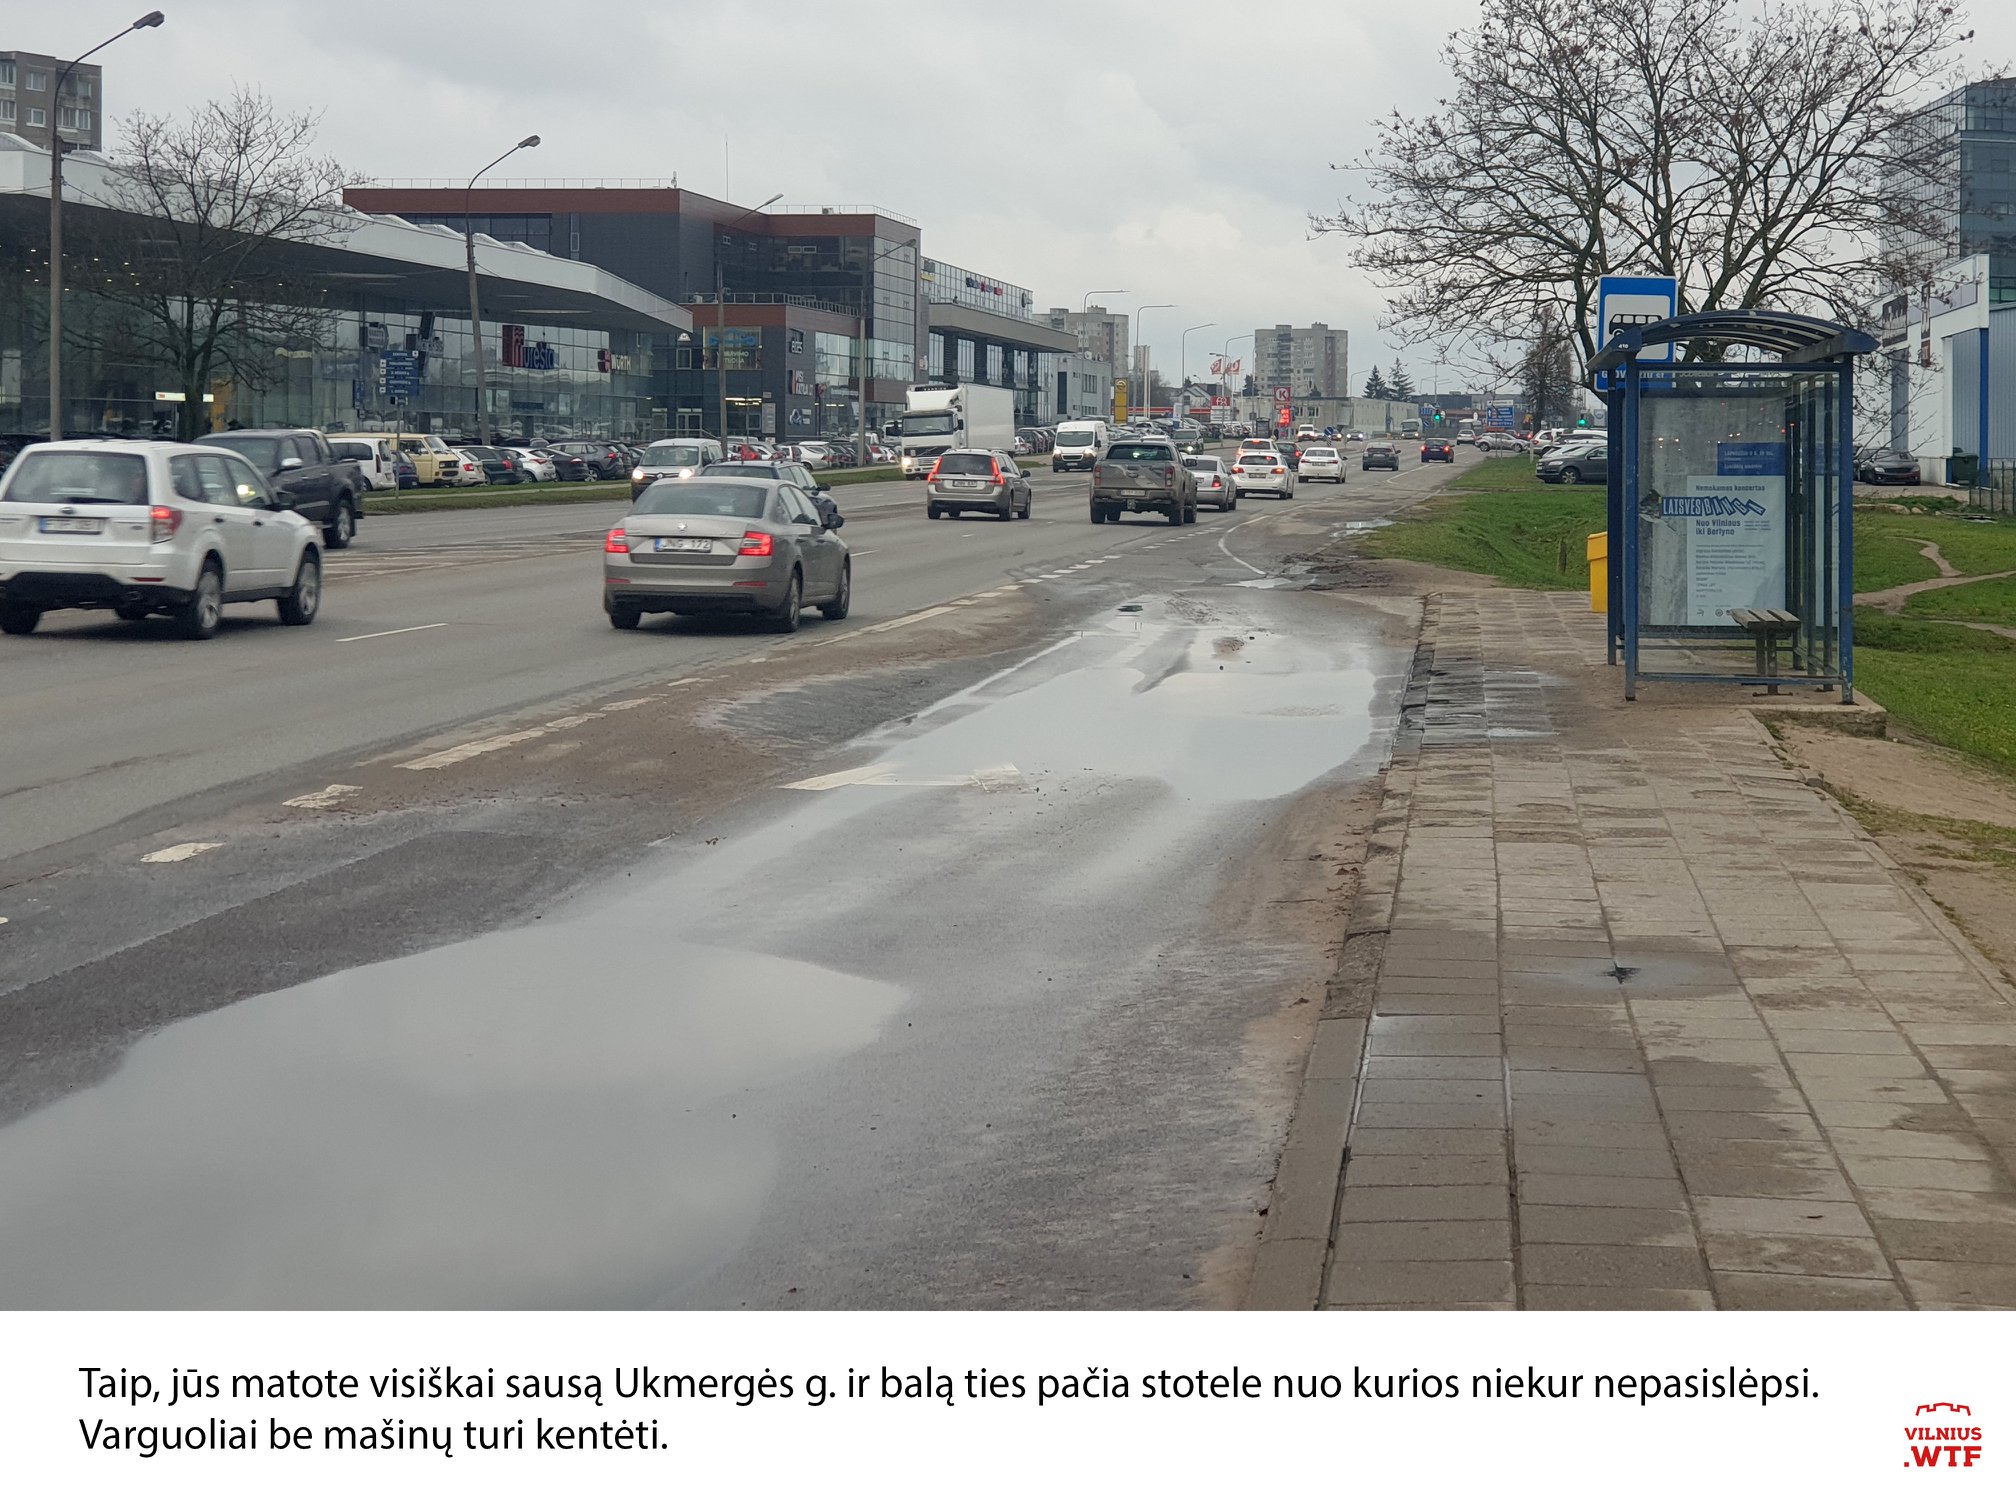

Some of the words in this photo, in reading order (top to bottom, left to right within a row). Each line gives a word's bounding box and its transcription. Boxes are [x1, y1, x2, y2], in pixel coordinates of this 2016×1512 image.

[1695, 519, 1710, 527] Nuo
[1711, 519, 1741, 527] Vilniaus
[1707, 528, 1735, 537] Berlyno
